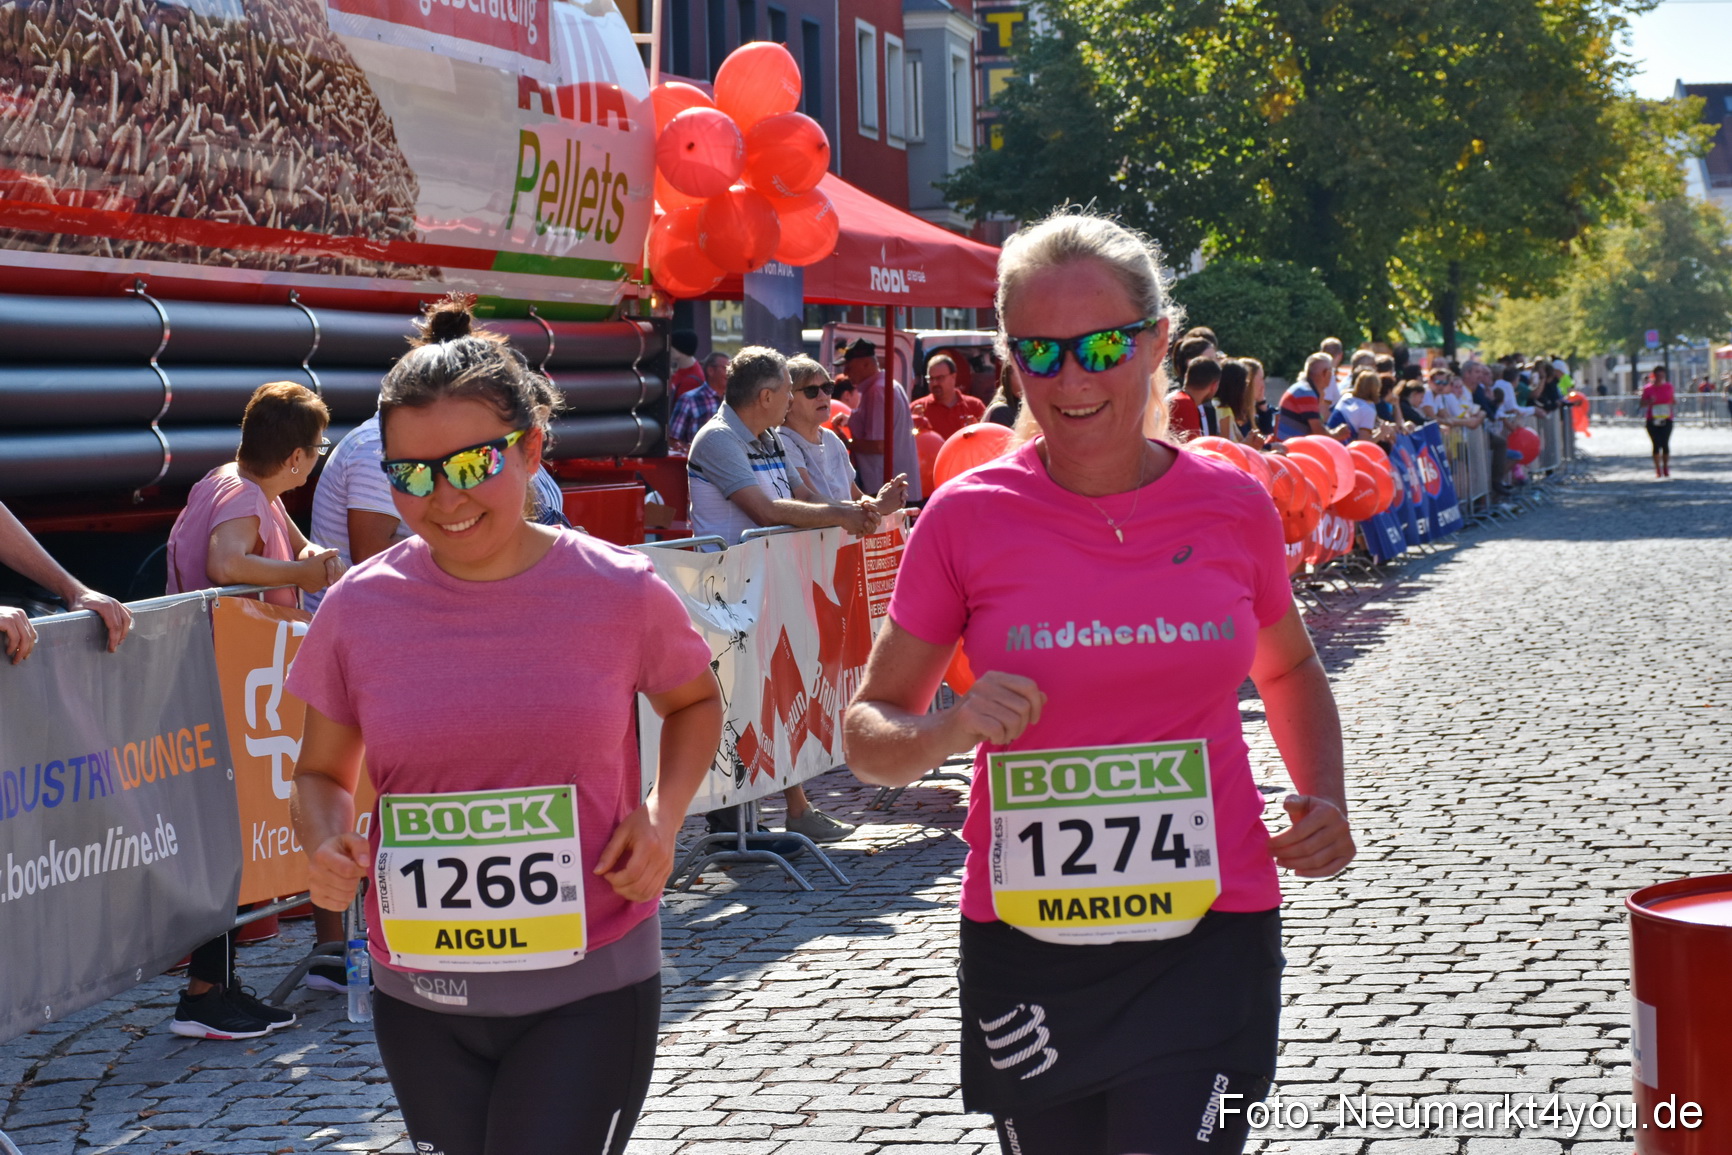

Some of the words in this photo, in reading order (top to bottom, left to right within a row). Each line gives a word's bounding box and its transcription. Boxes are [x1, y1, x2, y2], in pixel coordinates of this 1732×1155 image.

[504, 129, 629, 244] Pellets
[1006, 615, 1236, 653] Mädchenband
[113, 723, 217, 791] LOUNGE
[1008, 752, 1187, 802] BOCK
[394, 796, 556, 840] BOCK
[1194, 815, 1204, 826] D
[0, 813, 178, 902] .bockonline.de
[562, 855, 571, 864] D
[1018, 814, 1191, 877] 1274
[400, 852, 559, 909] 1266
[1038, 892, 1173, 922] MARION
[435, 927, 527, 950] AIGUL
